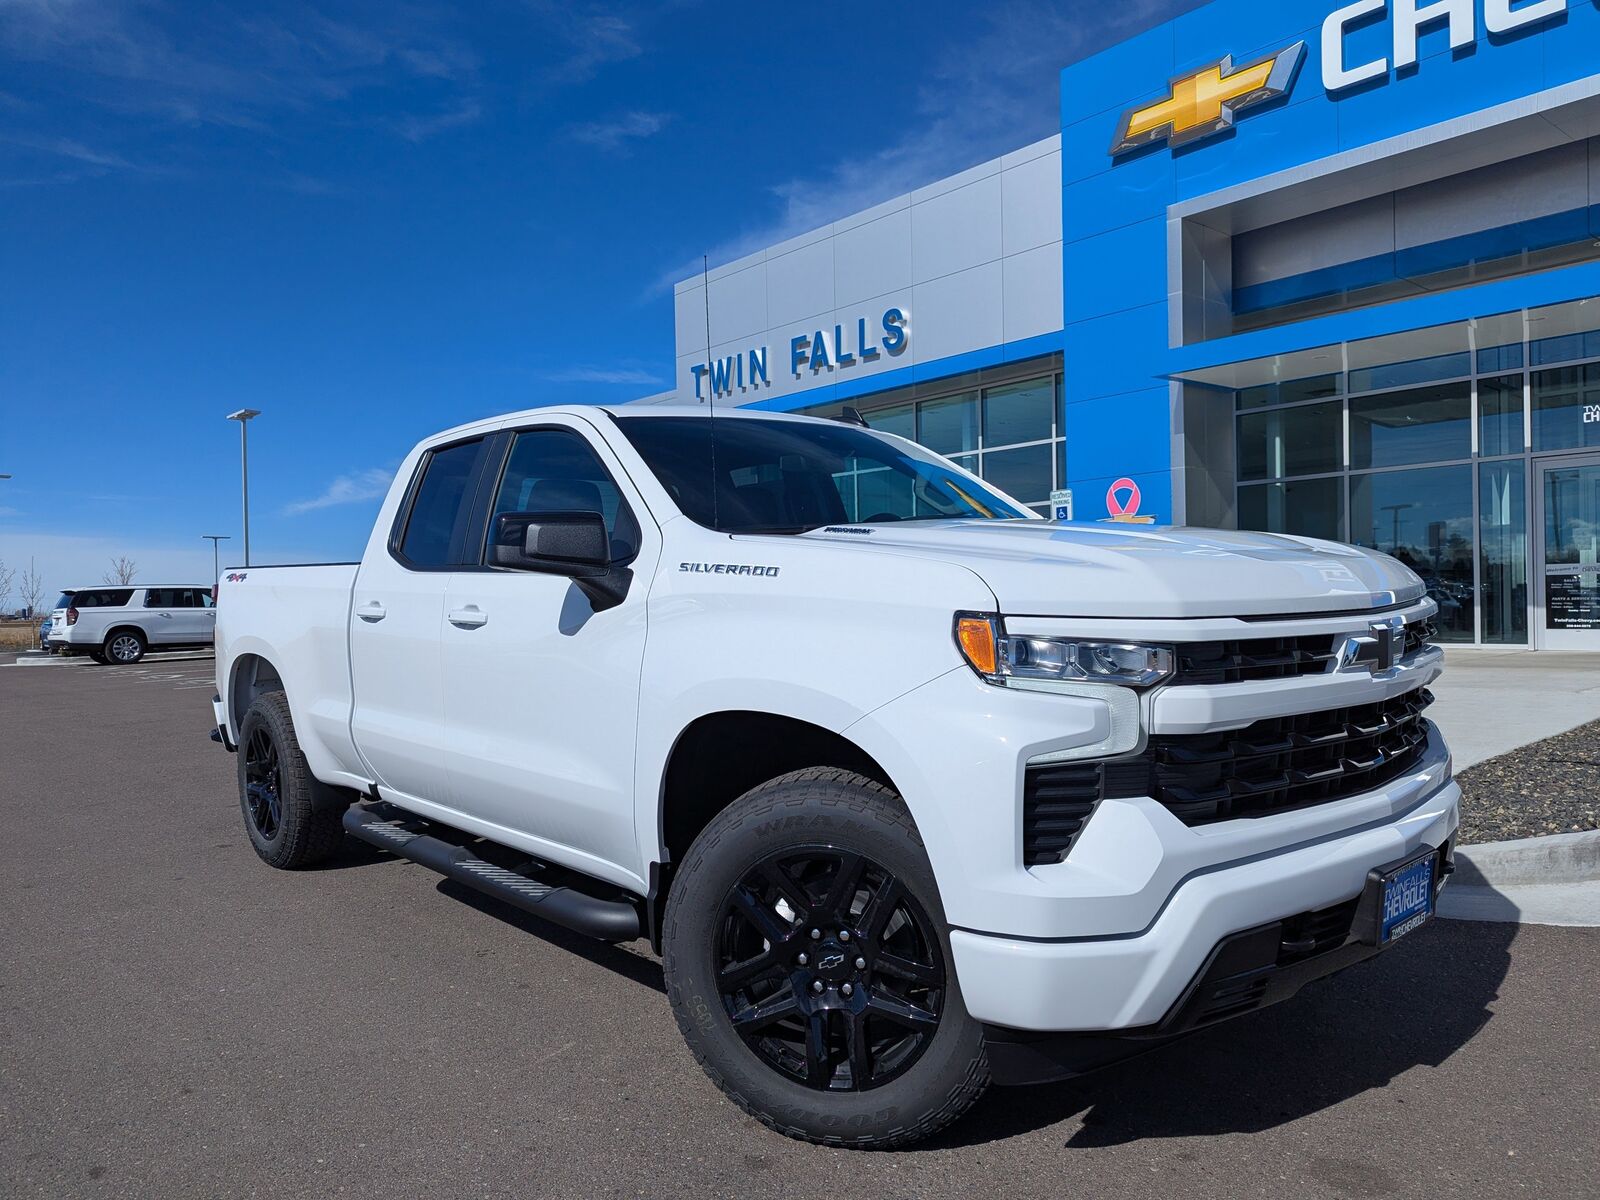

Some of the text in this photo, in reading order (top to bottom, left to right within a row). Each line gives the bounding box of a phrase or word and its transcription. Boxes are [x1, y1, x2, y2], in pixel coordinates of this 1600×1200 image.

[690, 307, 906, 399] TWIN FALLS
[1053, 498, 1070, 506] PARKING
[678, 561, 780, 578] SILVERADO
